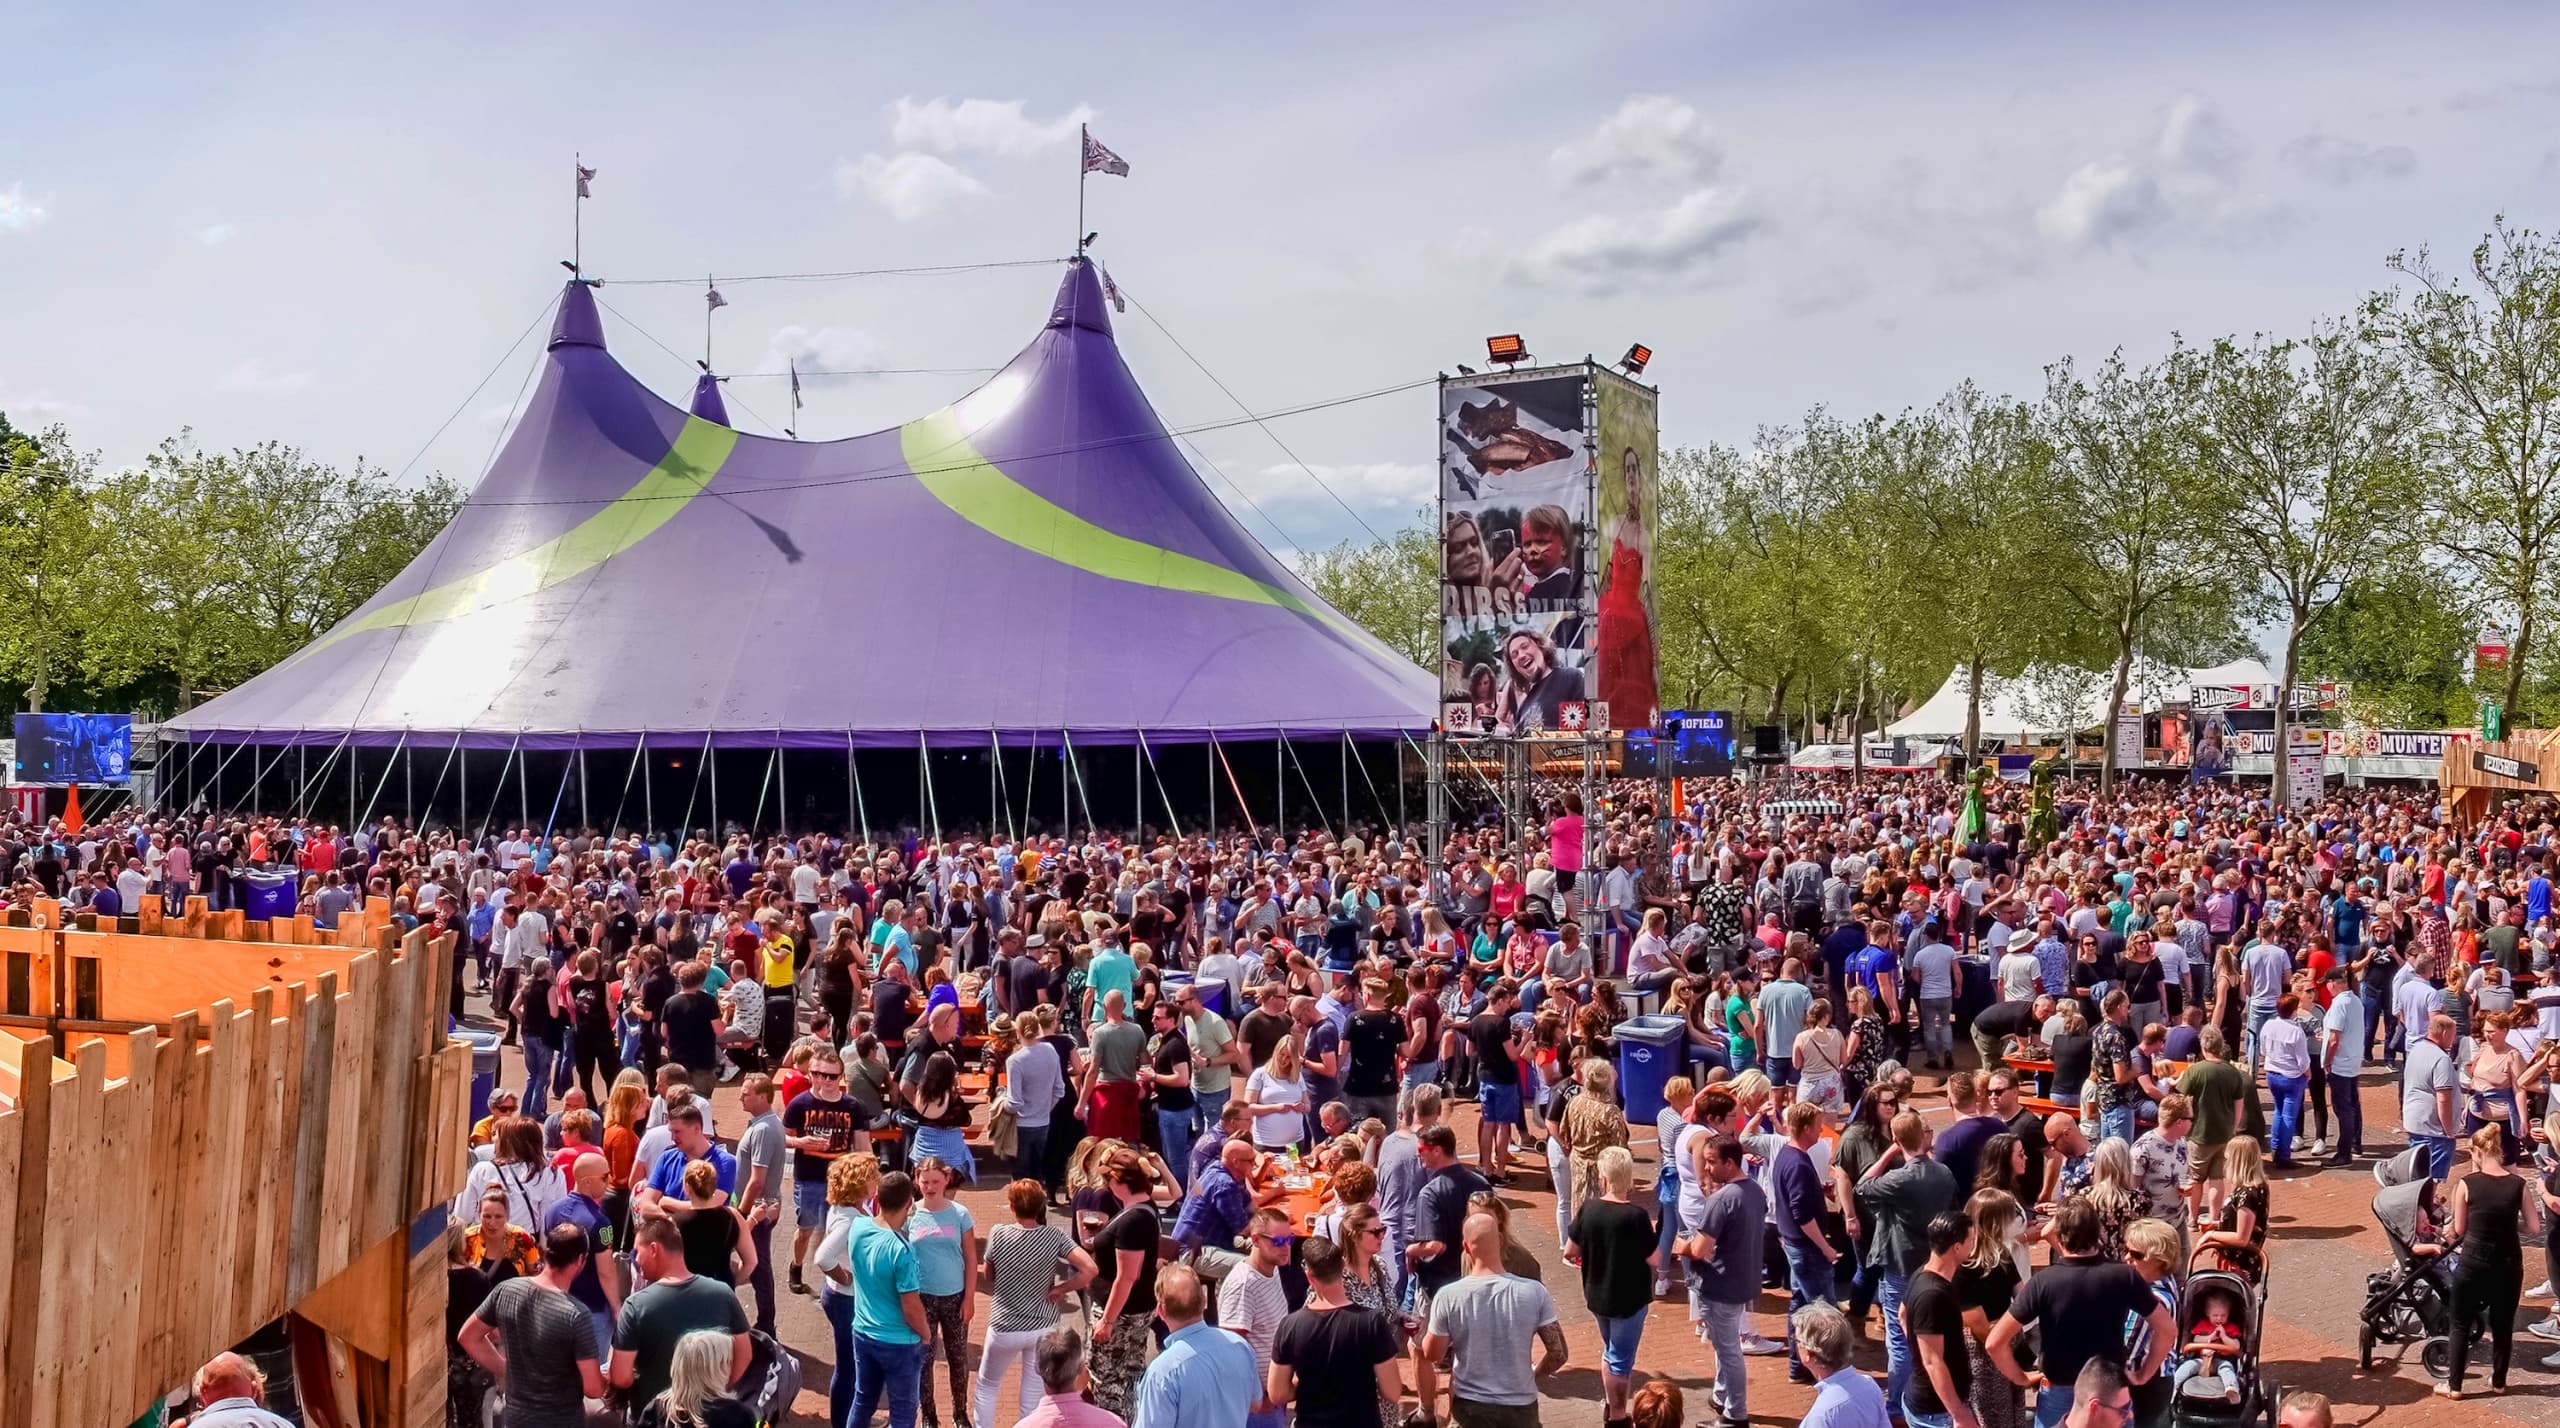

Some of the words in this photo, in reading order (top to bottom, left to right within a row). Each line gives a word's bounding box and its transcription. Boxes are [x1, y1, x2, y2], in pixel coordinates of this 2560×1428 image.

[1665, 718, 1724, 729] SHOFIELD
[2253, 734, 2276, 752] MU
[2381, 734, 2452, 755] MUNTEN
